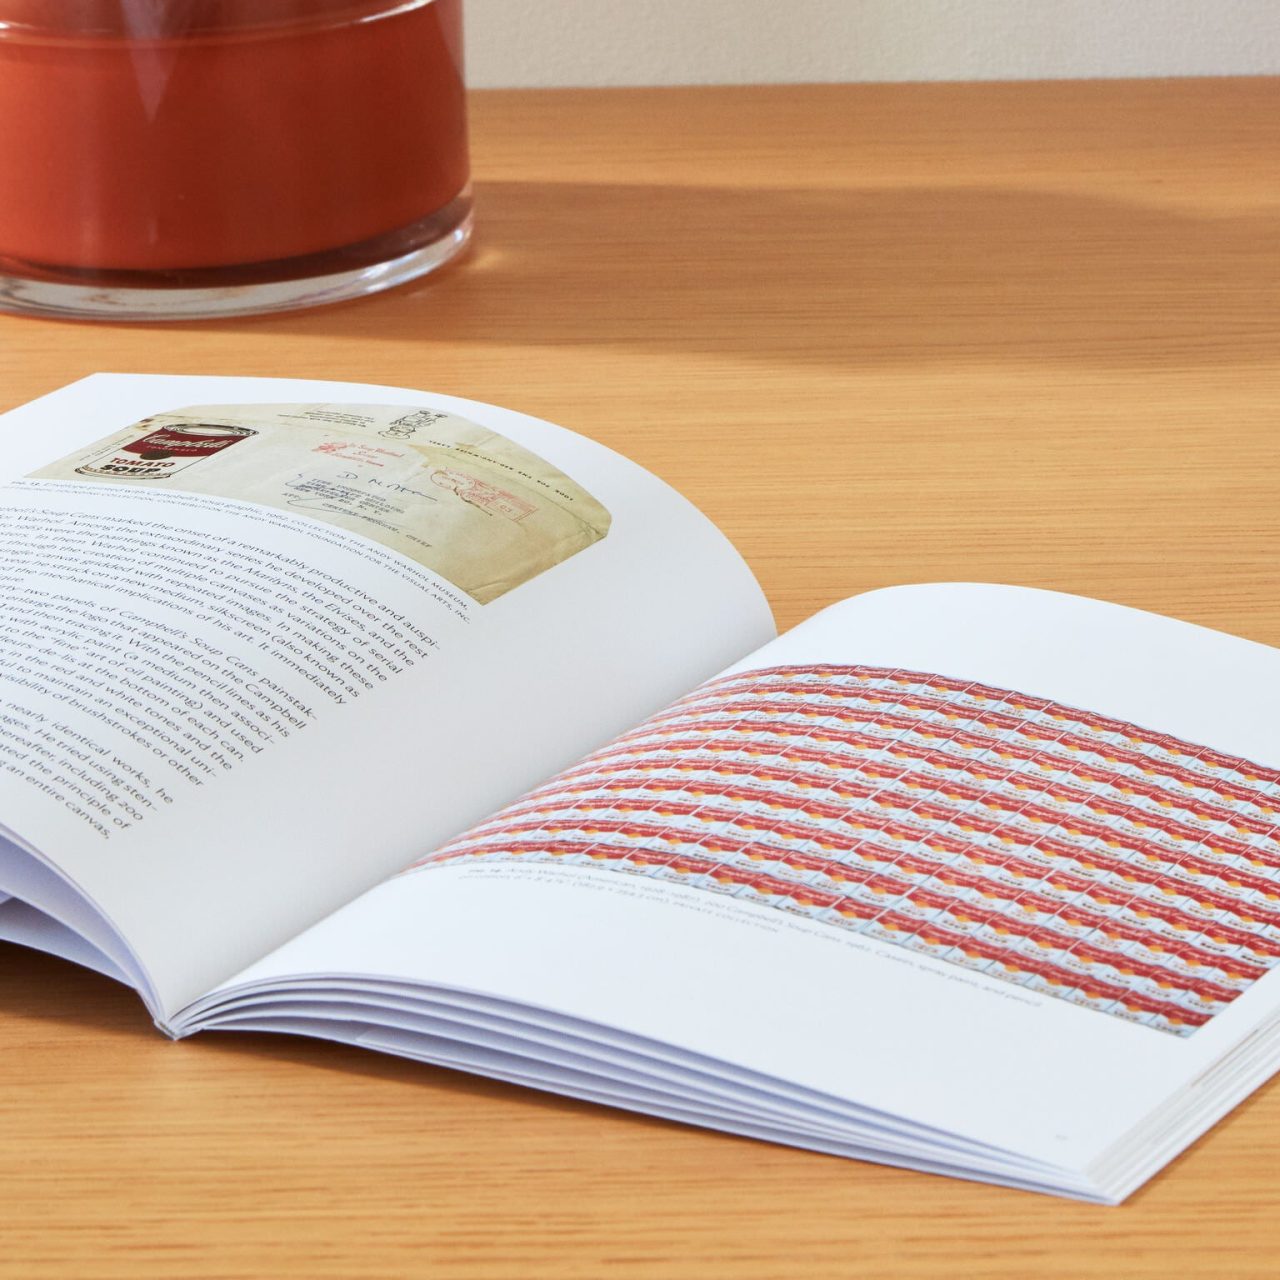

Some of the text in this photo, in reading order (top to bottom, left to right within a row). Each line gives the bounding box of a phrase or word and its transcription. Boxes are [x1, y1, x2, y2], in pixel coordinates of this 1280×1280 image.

[100, 464, 161, 473] SOUP
[110, 457, 175, 468] TOMATO
[140, 531, 429, 659] extraordinary series developed over the rest
[239, 541, 440, 650] remarkably productive and auspi-
[307, 532, 431, 593] FOUNDATION VISUAL
[368, 547, 468, 611] ANDY WARHOL MUSEUM,
[115, 587, 347, 705] implications his art. immediately
[140, 550, 404, 675] continued pursue the strategy of serial
[150, 585, 360, 698] medium, silkscreen (also known as
[154, 563, 388, 682] multiple canvases variations on the
[165, 578, 374, 689] repeated images. making these
[302, 591, 415, 667] the Elvises, and the
[84, 638, 276, 744] paint medium then associ-
[119, 610, 318, 720] Campbell's Soup Cans painstak-
[128, 637, 290, 738] With the pencil lines as his
[138, 631, 307, 729] appeared on the Campbell
[6, 702, 173, 804] nearly identical works, he
[34, 671, 217, 777] maintain an exceptional uni-
[52, 692, 204, 786] of brushstrokes or other
[75, 674, 232, 770] and white tones and the
[95, 667, 244, 763] the bottom of each can.
[142, 675, 264, 754] painting) and used
[25, 775, 111, 839] entire canvas,
[29, 759, 132, 829] the principle of
[34, 728, 158, 811] He tried using sten-
[58, 759, 144, 821] including 200
